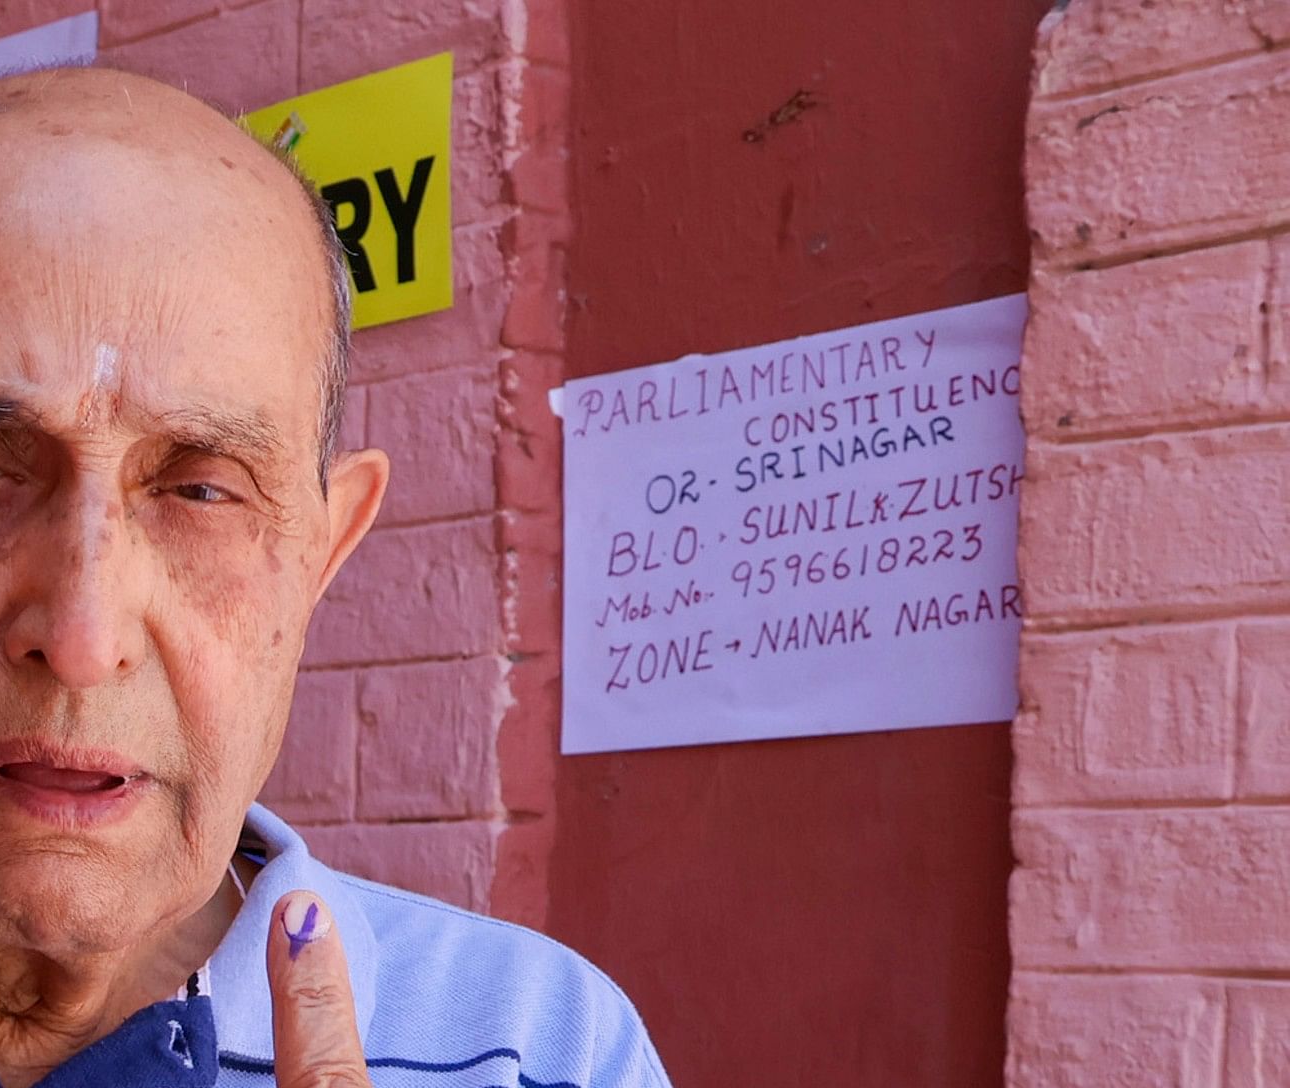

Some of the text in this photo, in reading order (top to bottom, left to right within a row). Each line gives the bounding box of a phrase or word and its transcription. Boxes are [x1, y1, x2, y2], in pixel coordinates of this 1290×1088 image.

[573, 329, 936, 436] PARLIAMENTARY
[735, 416, 955, 493] SRINAGAR
[731, 524, 982, 598] 9596618223
[606, 584, 1023, 694] ZONE NANAK NAGAR
